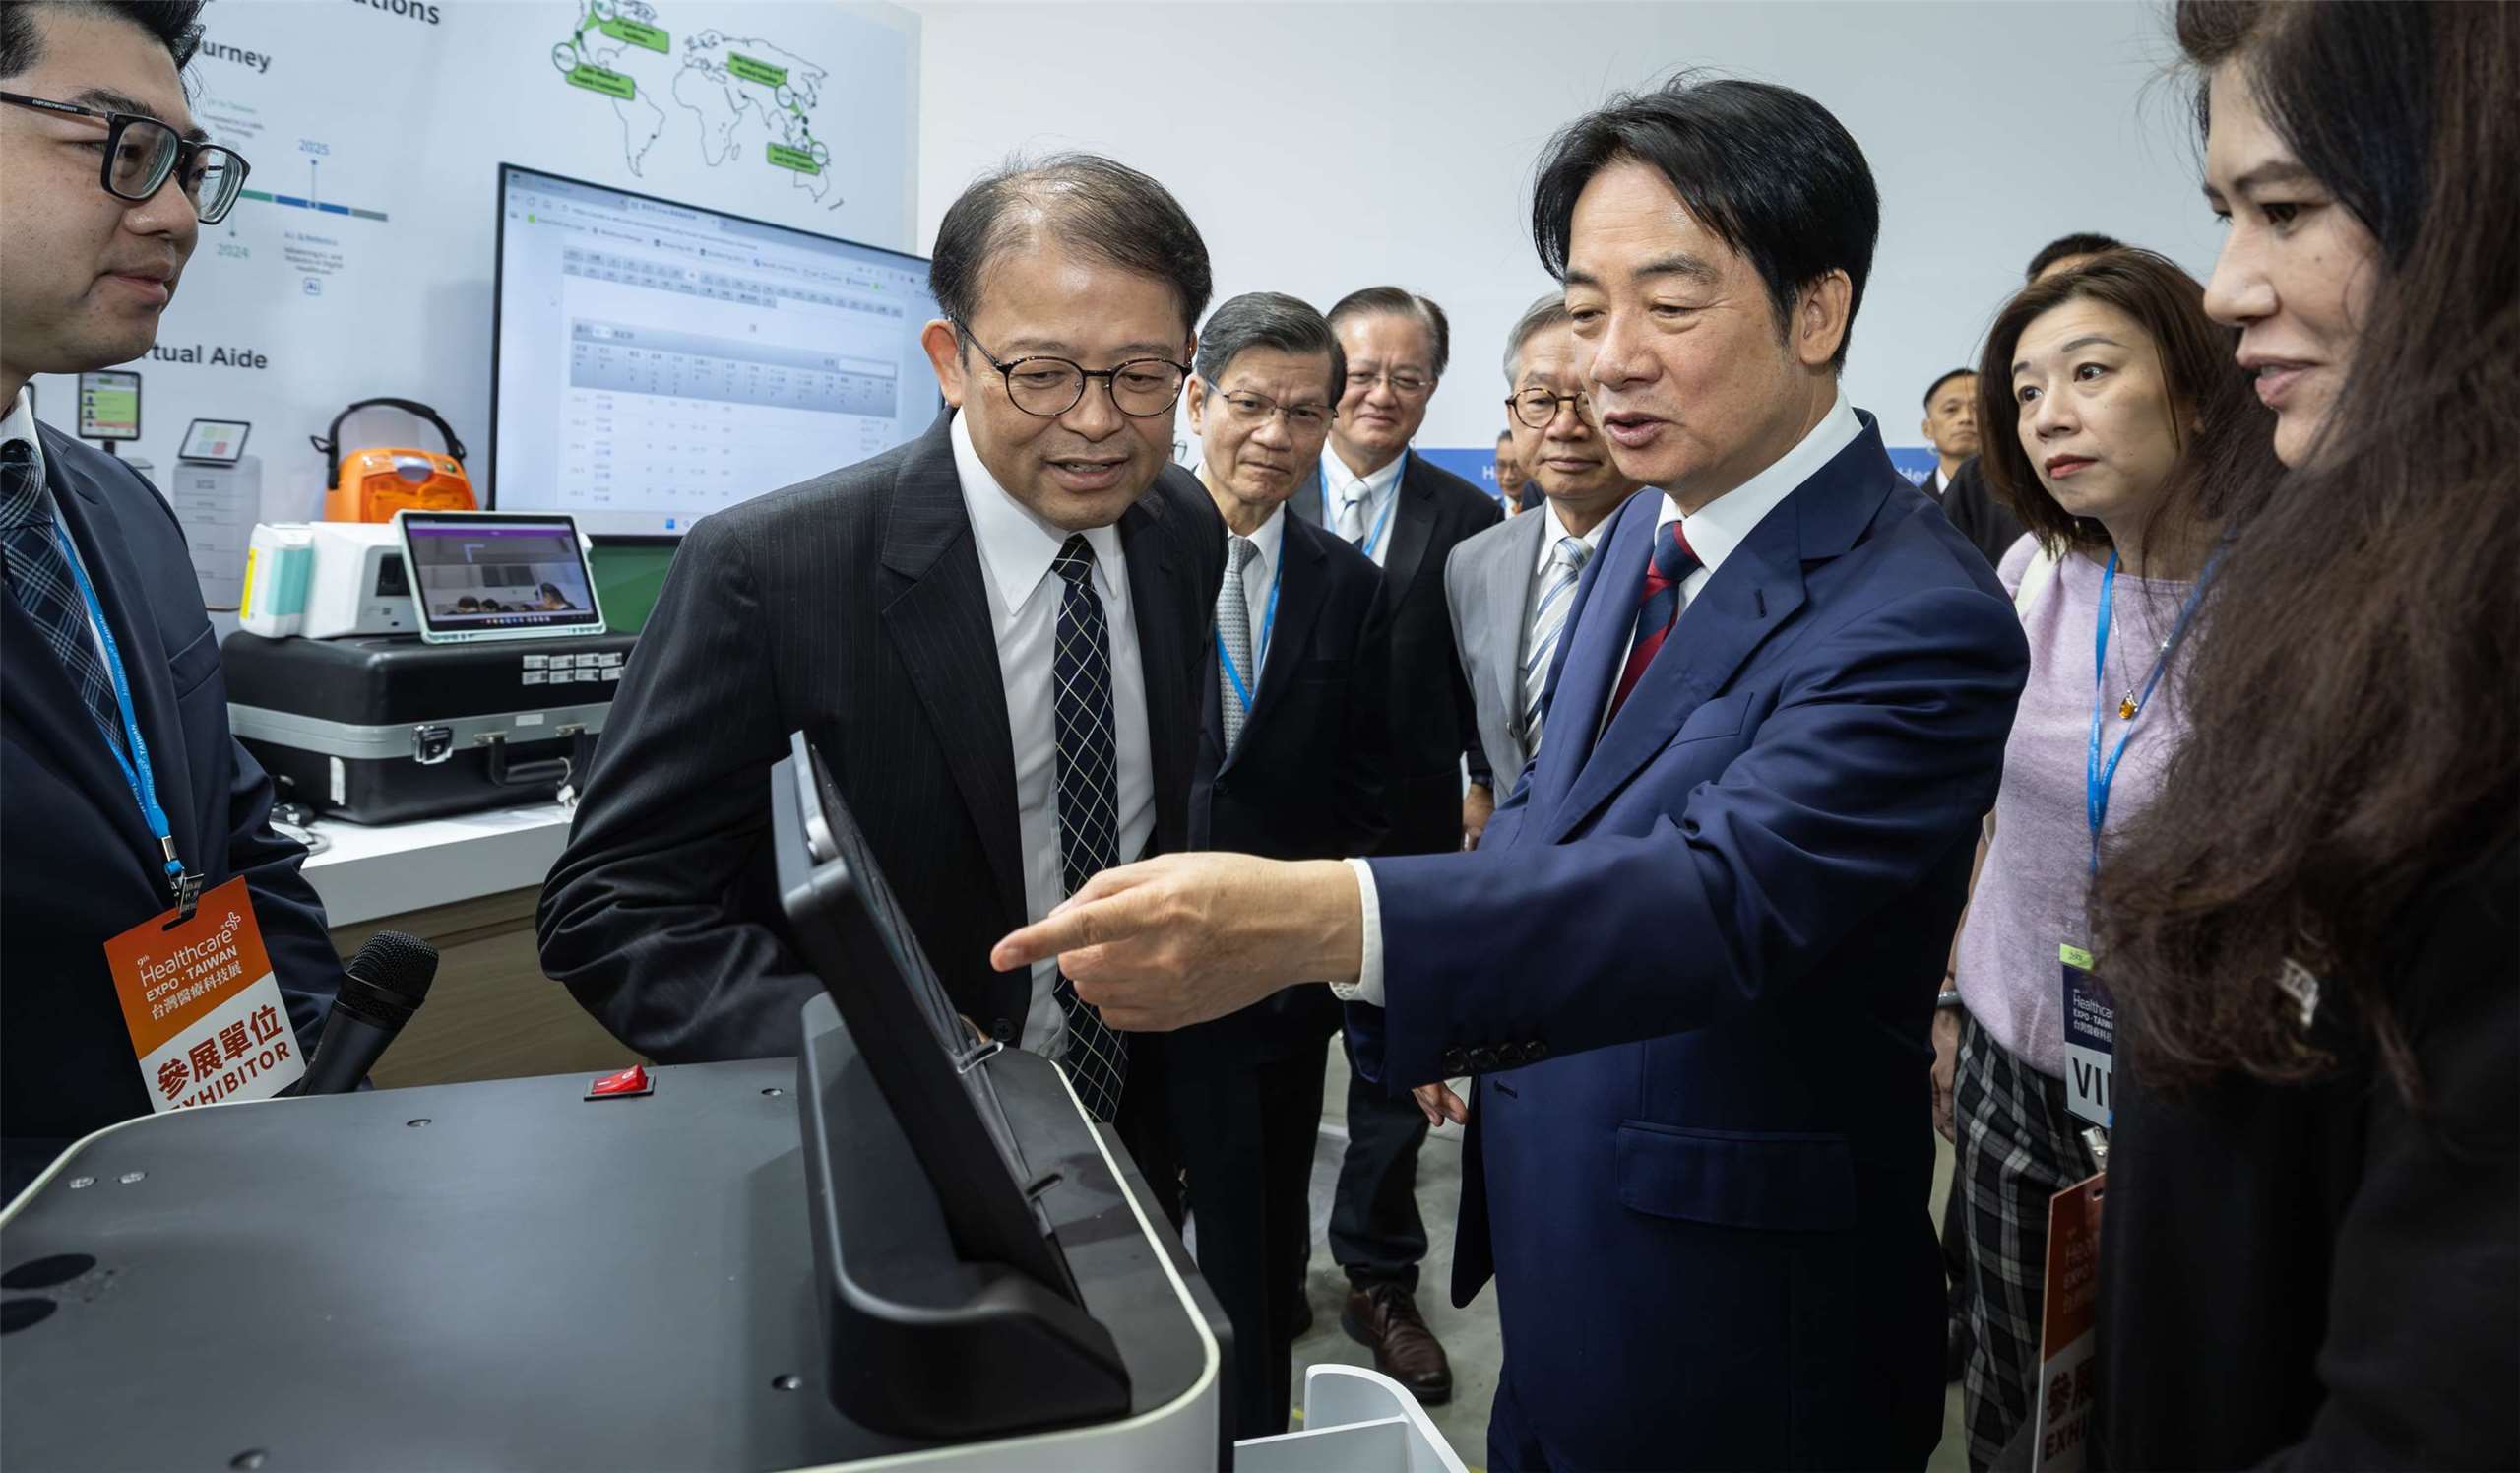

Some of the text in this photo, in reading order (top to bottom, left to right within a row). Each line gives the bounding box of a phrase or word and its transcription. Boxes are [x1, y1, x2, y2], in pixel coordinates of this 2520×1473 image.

[201, 40, 272, 74] urney
[209, 346, 269, 369] Aide
[140, 929, 233, 988] Healthcare
[146, 944, 238, 1003] EXPO TAIWAN
[158, 1004, 284, 1101] 參展單位
